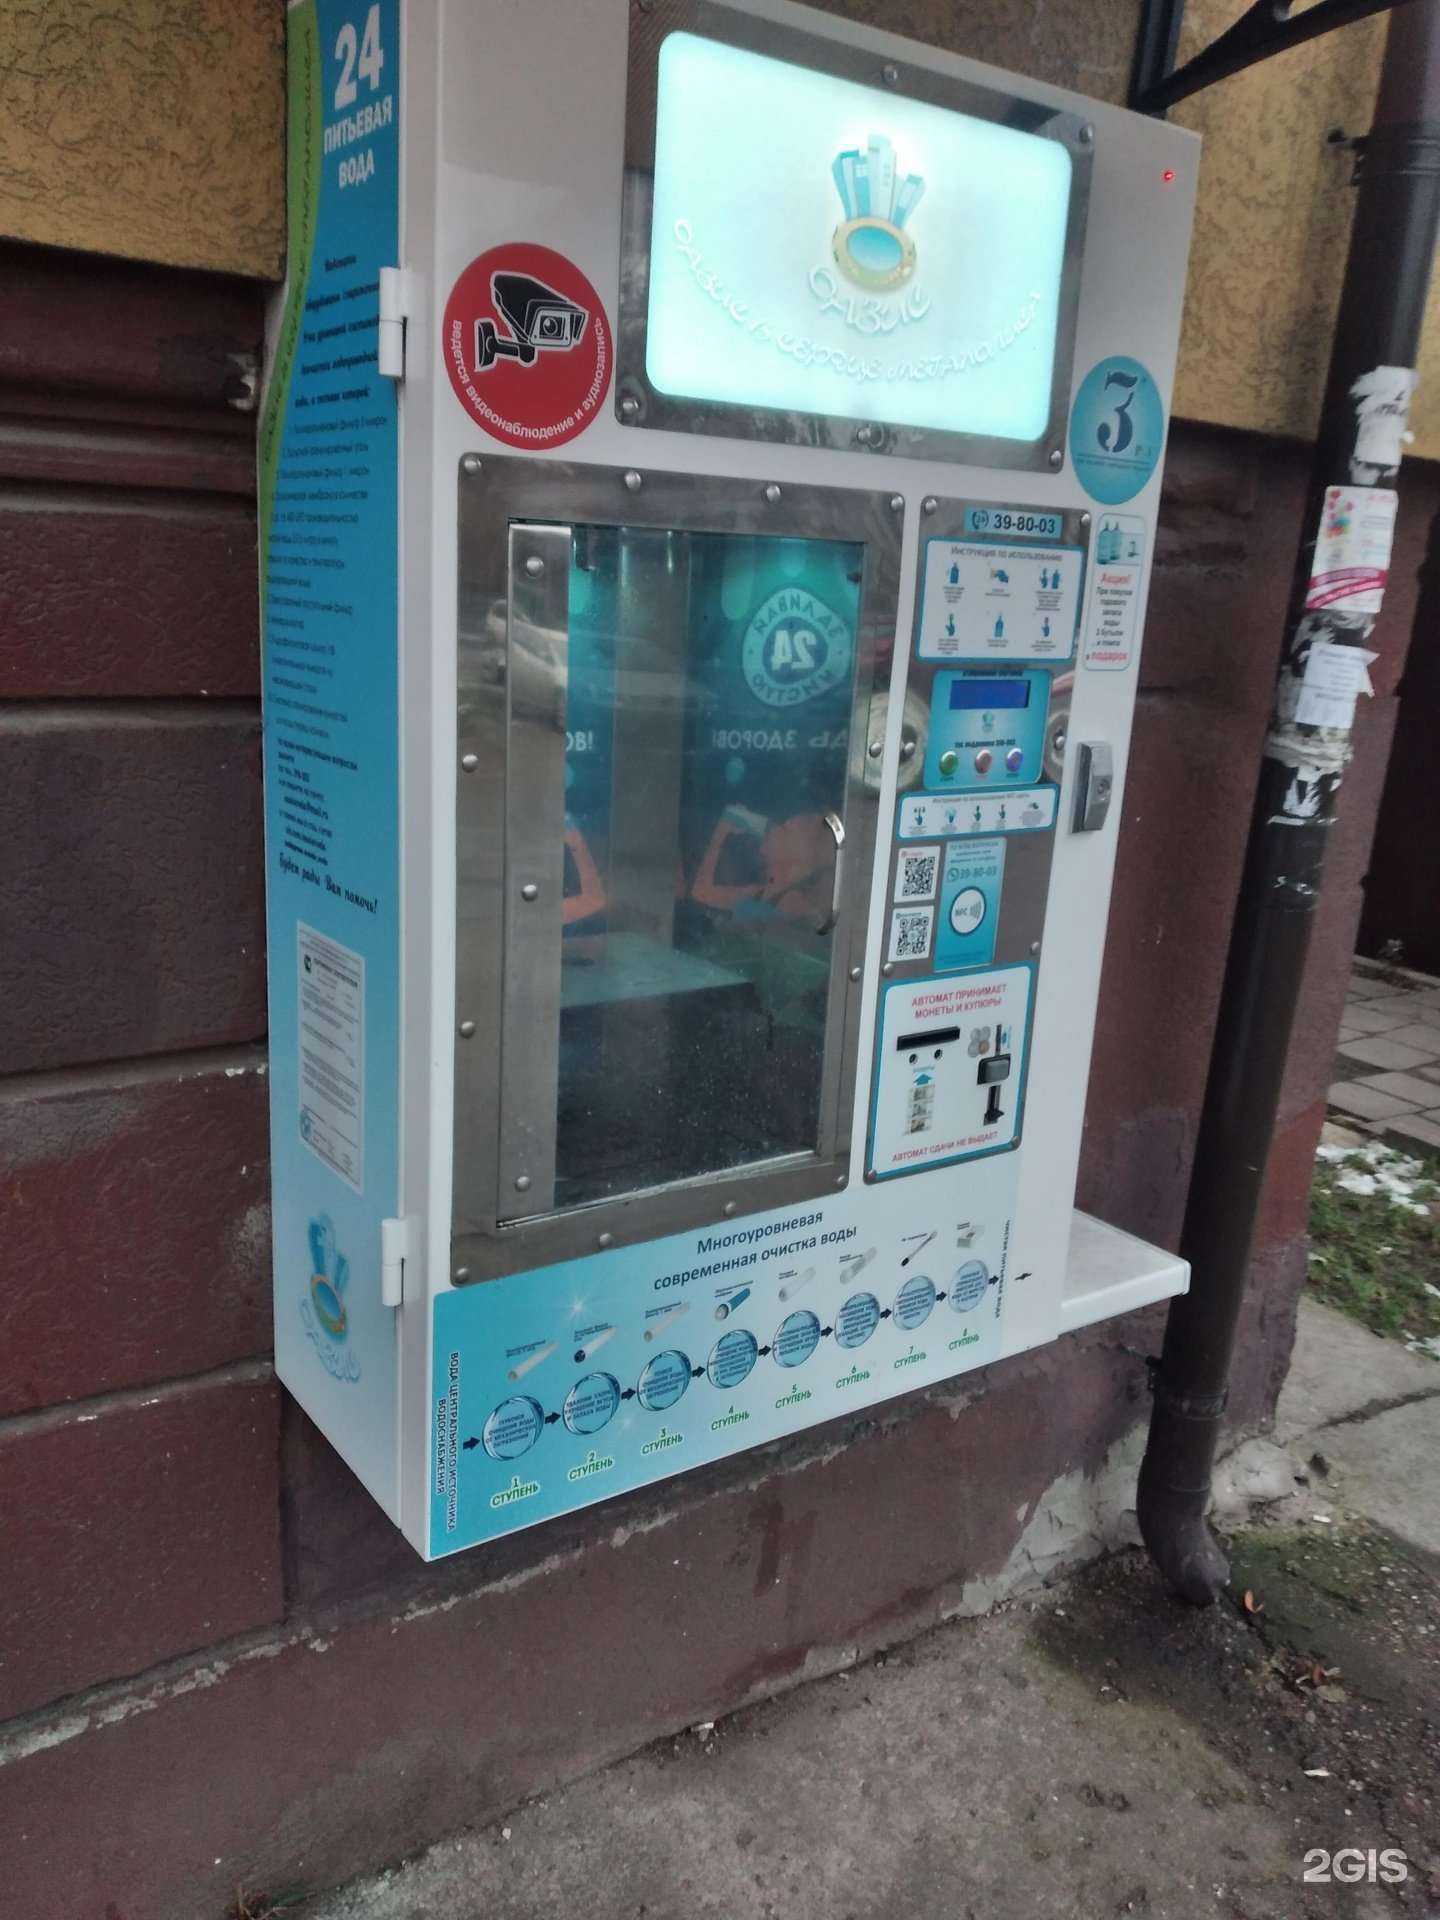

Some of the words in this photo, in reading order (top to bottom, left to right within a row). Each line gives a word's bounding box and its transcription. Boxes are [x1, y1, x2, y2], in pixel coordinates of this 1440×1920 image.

[335, 4, 384, 108] 24
[324, 95, 392, 155] ПИТЬЕВАЯ
[338, 149, 375, 189] ВОДА
[453, 320, 470, 384] ведется
[466, 385, 575, 440] видеонаблюдение
[574, 409, 584, 420] и
[582, 317, 606, 411] аудиозапись
[1096, 371, 1138, 453] 3
[993, 513, 1056, 535] 39-80-03
[911, 991, 953, 1007] АВТОМАТ
[955, 984, 1008, 1001] ПРИНИМАЕТ
[914, 1005, 954, 1019] МОНЕТЫ
[955, 1003, 963, 1012] И
[963, 998, 1002, 1011] КУПЮРЫ
[892, 1147, 929, 1162] АВТОМАТ
[956, 1138, 966, 1147] НЕ
[697, 1210, 823, 1256] Многоуровневая
[653, 1252, 757, 1291] современная
[761, 1236, 816, 1264] очистка
[820, 1226, 857, 1246] воды
[948, 1334, 980, 1351] СТУПЕНЬ
[449, 1352, 459, 1381] ВОДА
[851, 1366, 857, 1374] 6
[894, 1352, 927, 1369] СТУПЕНЬ
[791, 1384, 797, 1392] 5
[835, 1371, 871, 1389] СТУПЕНЬ
[728, 1406, 734, 1414] 4
[775, 1390, 812, 1409] СТУПЕНЬ
[449, 1383, 459, 1466] ЦЕНТРАЛЬНОГО
[710, 1411, 750, 1430] СТУПЕНЬ
[641, 1434, 683, 1454] СТУПЕНЬ
[661, 1428, 667, 1438] 3
[437, 1398, 446, 1494] ВОДОСНАБЖЕНИЯ
[588, 1452, 595, 1462] 2
[569, 1457, 613, 1480] СТУПЕНЬ
[513, 1478, 519, 1487] 1
[447, 1469, 458, 1531] ИСТОЧНИКА
[492, 1484, 538, 1506] СТУПЕНЬ
